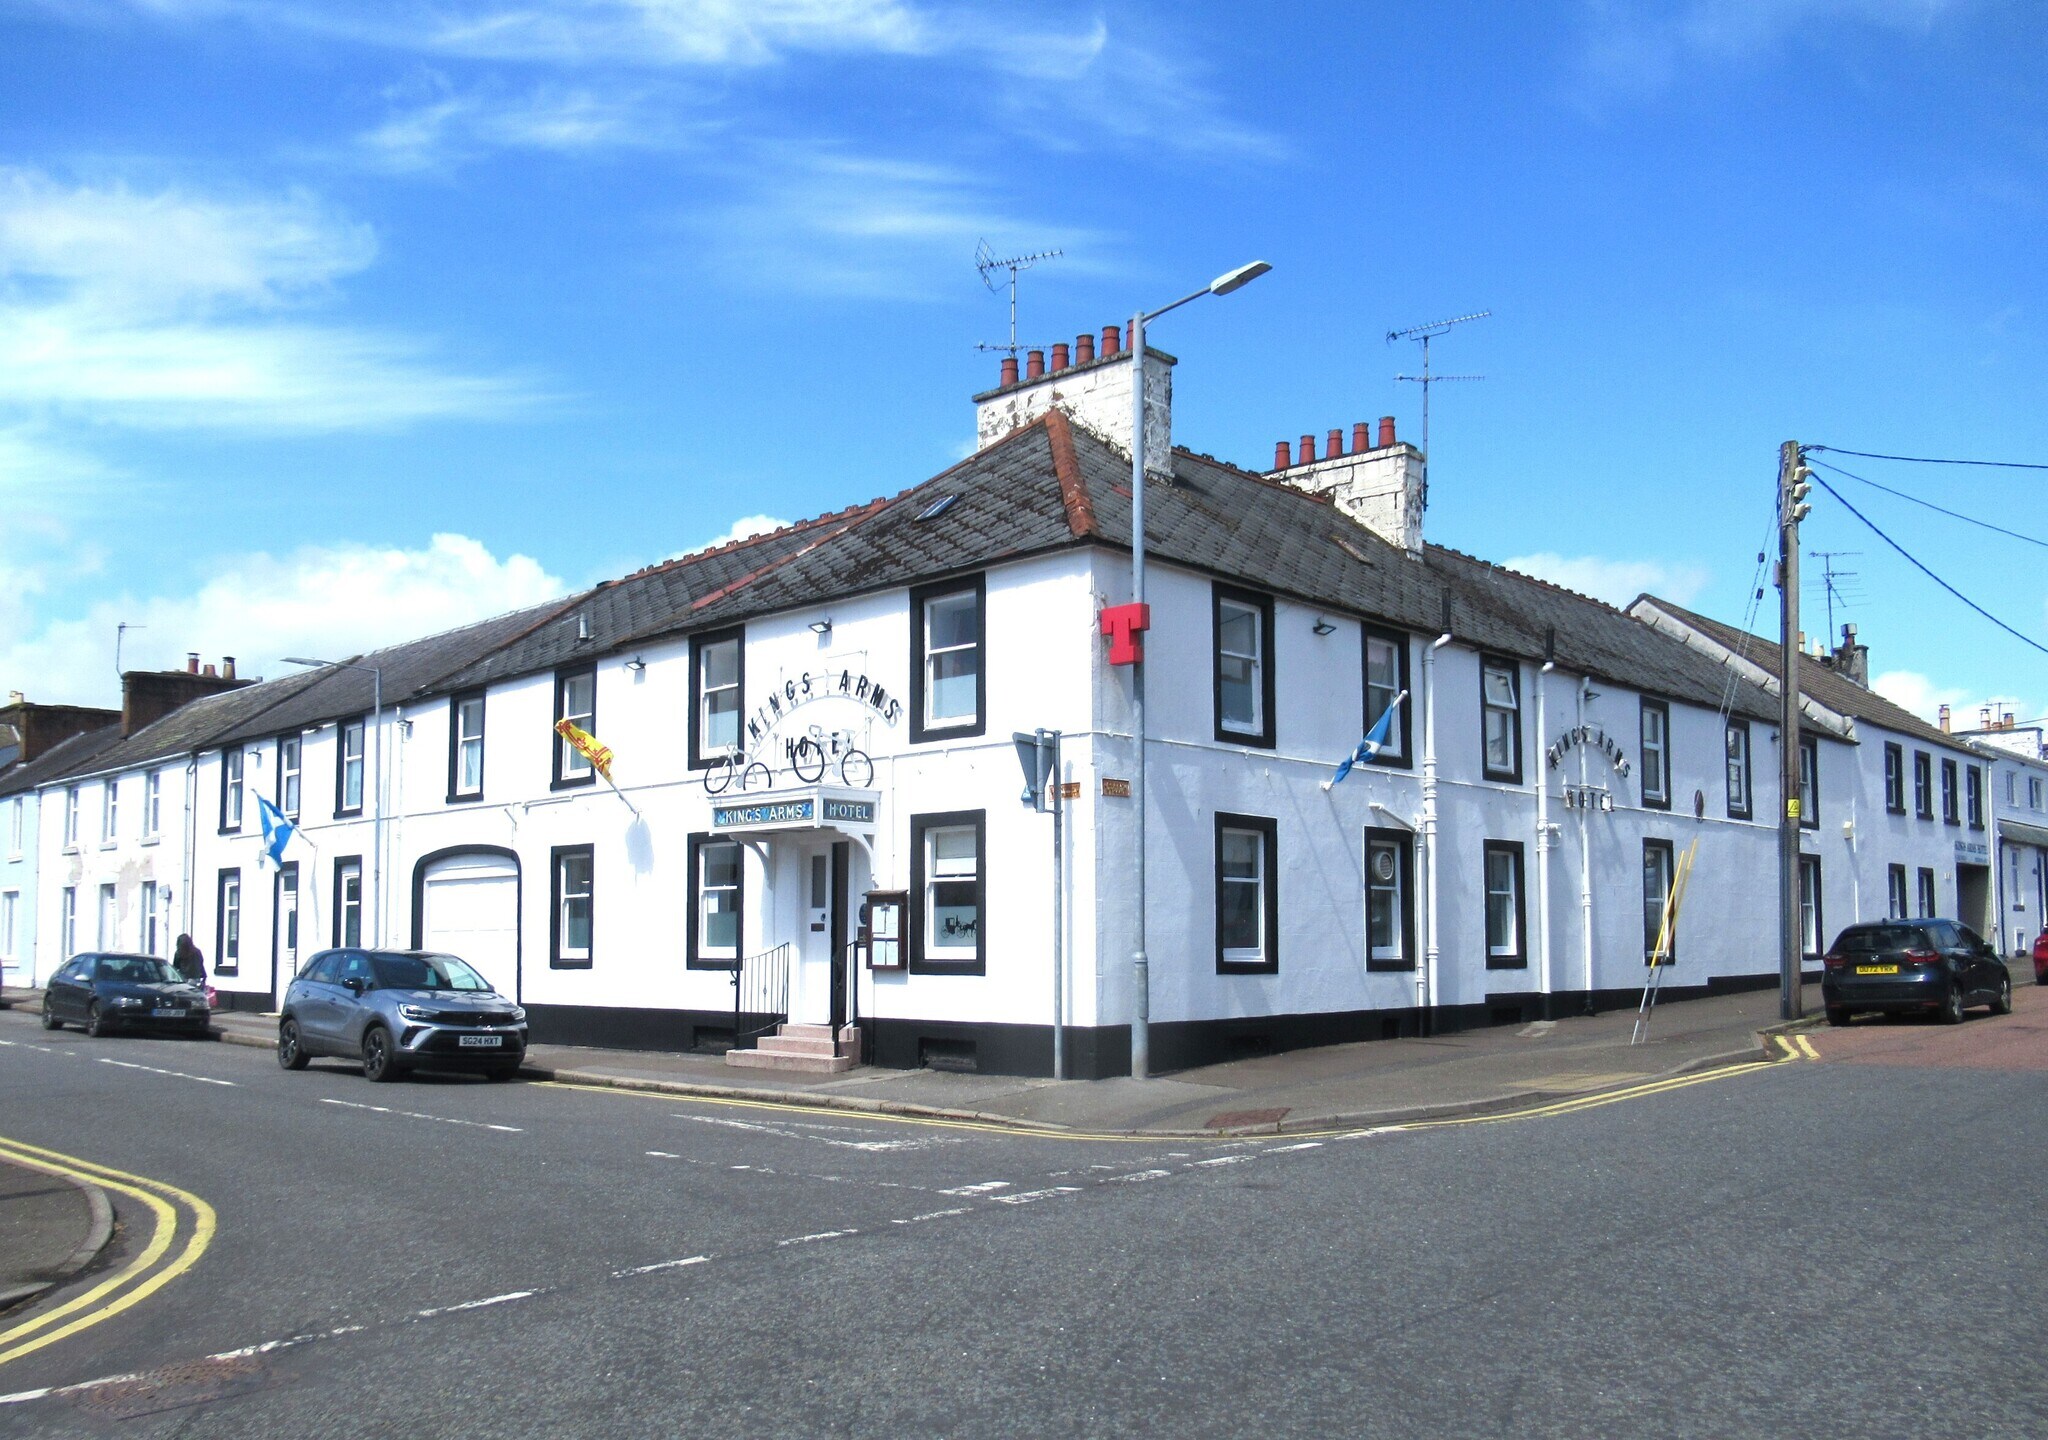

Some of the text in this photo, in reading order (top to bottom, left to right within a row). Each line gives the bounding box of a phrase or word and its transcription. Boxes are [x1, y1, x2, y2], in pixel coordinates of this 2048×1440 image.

[1101, 602, 1150, 666] T
[748, 669, 899, 739] KINGS ARMS
[1597, 730, 1631, 778] ARMS
[829, 803, 869, 819] HOTEL
[1566, 789, 1615, 812] HOTEL
[725, 804, 805, 824] KING'S ARMS
[484, 1037, 499, 1045] HXT
